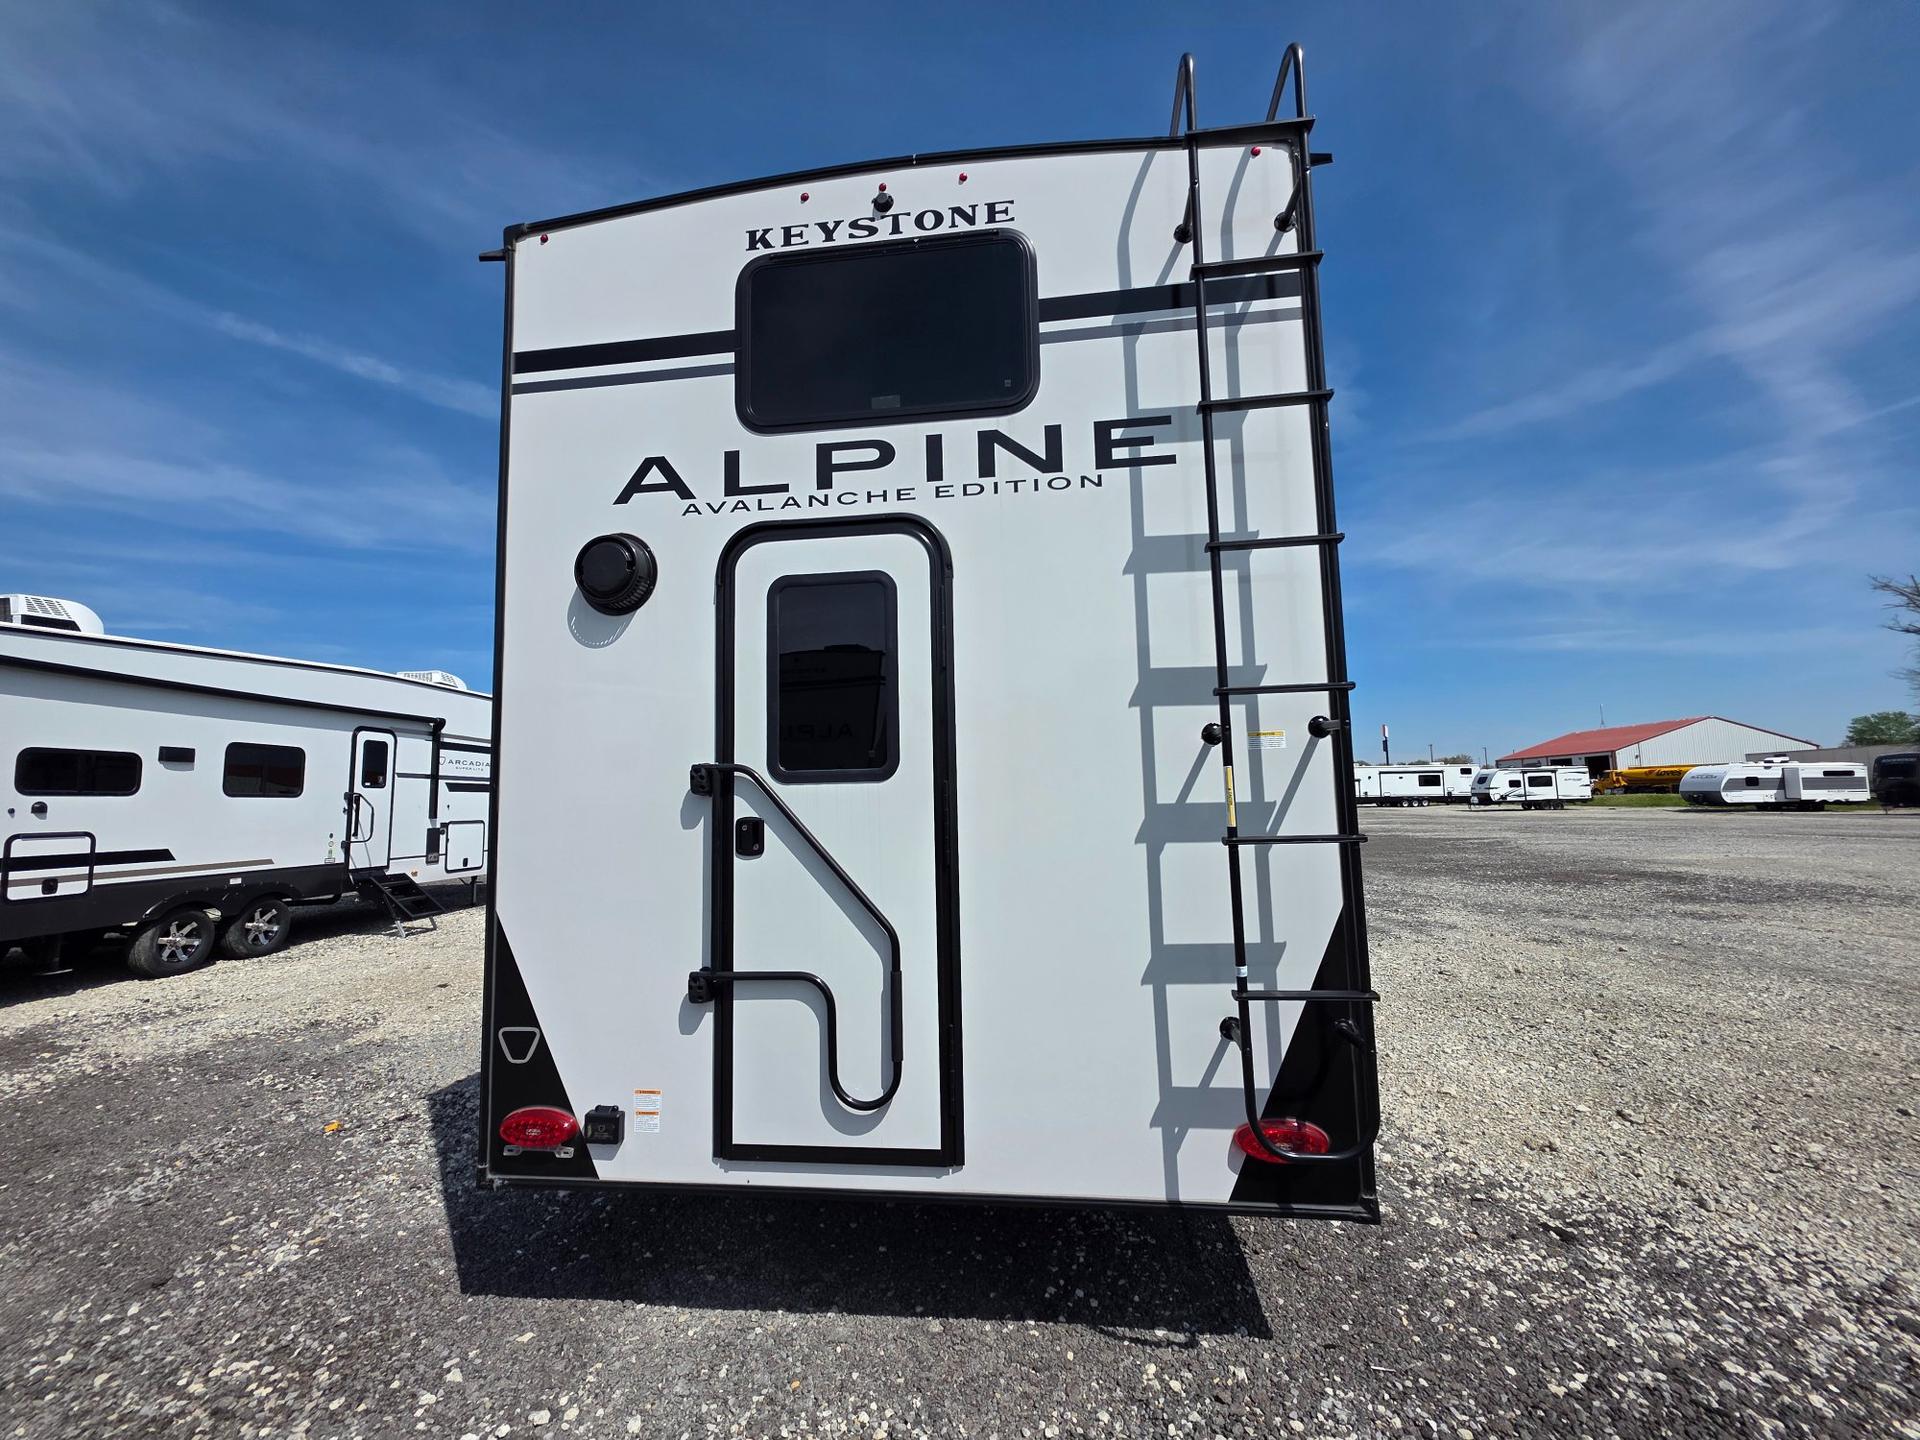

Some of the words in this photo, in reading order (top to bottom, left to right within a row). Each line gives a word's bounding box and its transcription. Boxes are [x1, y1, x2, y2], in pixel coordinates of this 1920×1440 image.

[746, 200, 1016, 251] KEYSTONE
[612, 415, 1177, 505] ALPINE
[682, 488, 916, 516] AVALANCHE
[935, 474, 1103, 498] EDITION
[448, 759, 491, 767] ARCADIA
